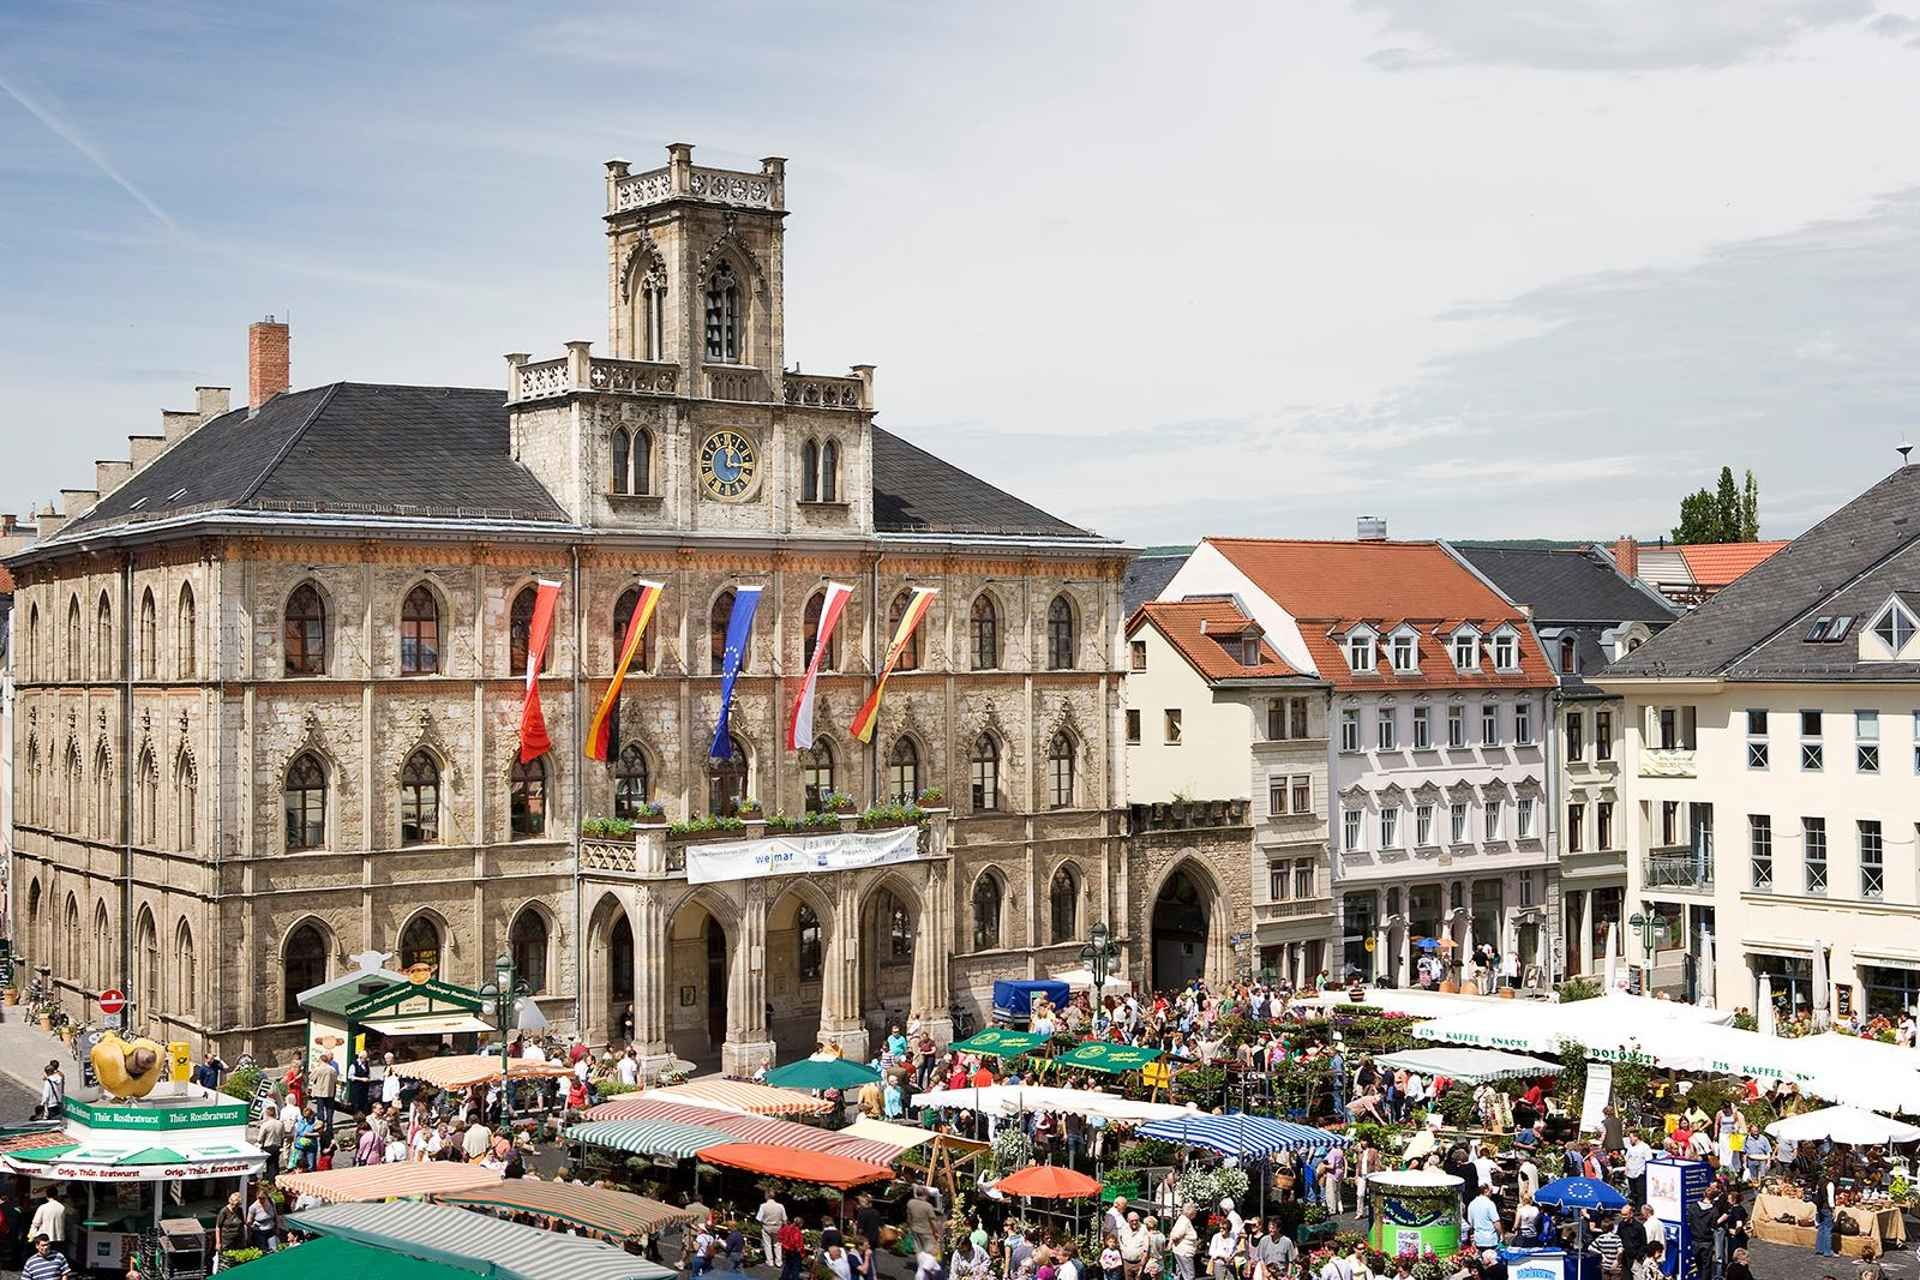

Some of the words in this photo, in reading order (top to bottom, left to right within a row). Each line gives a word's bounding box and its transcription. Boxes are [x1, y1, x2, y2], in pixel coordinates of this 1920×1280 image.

[1446, 1032, 1480, 1042] KAFFEE
[1491, 1037, 1528, 1048] SNACKS
[1712, 1061, 1729, 1070] EIS
[1743, 1065, 1783, 1078] KAFFEE
[190, 1111, 238, 1122] Rostbratwurst
[100, 1169, 140, 1178] Bratwurst
[210, 1163, 250, 1174] Bratwurst
